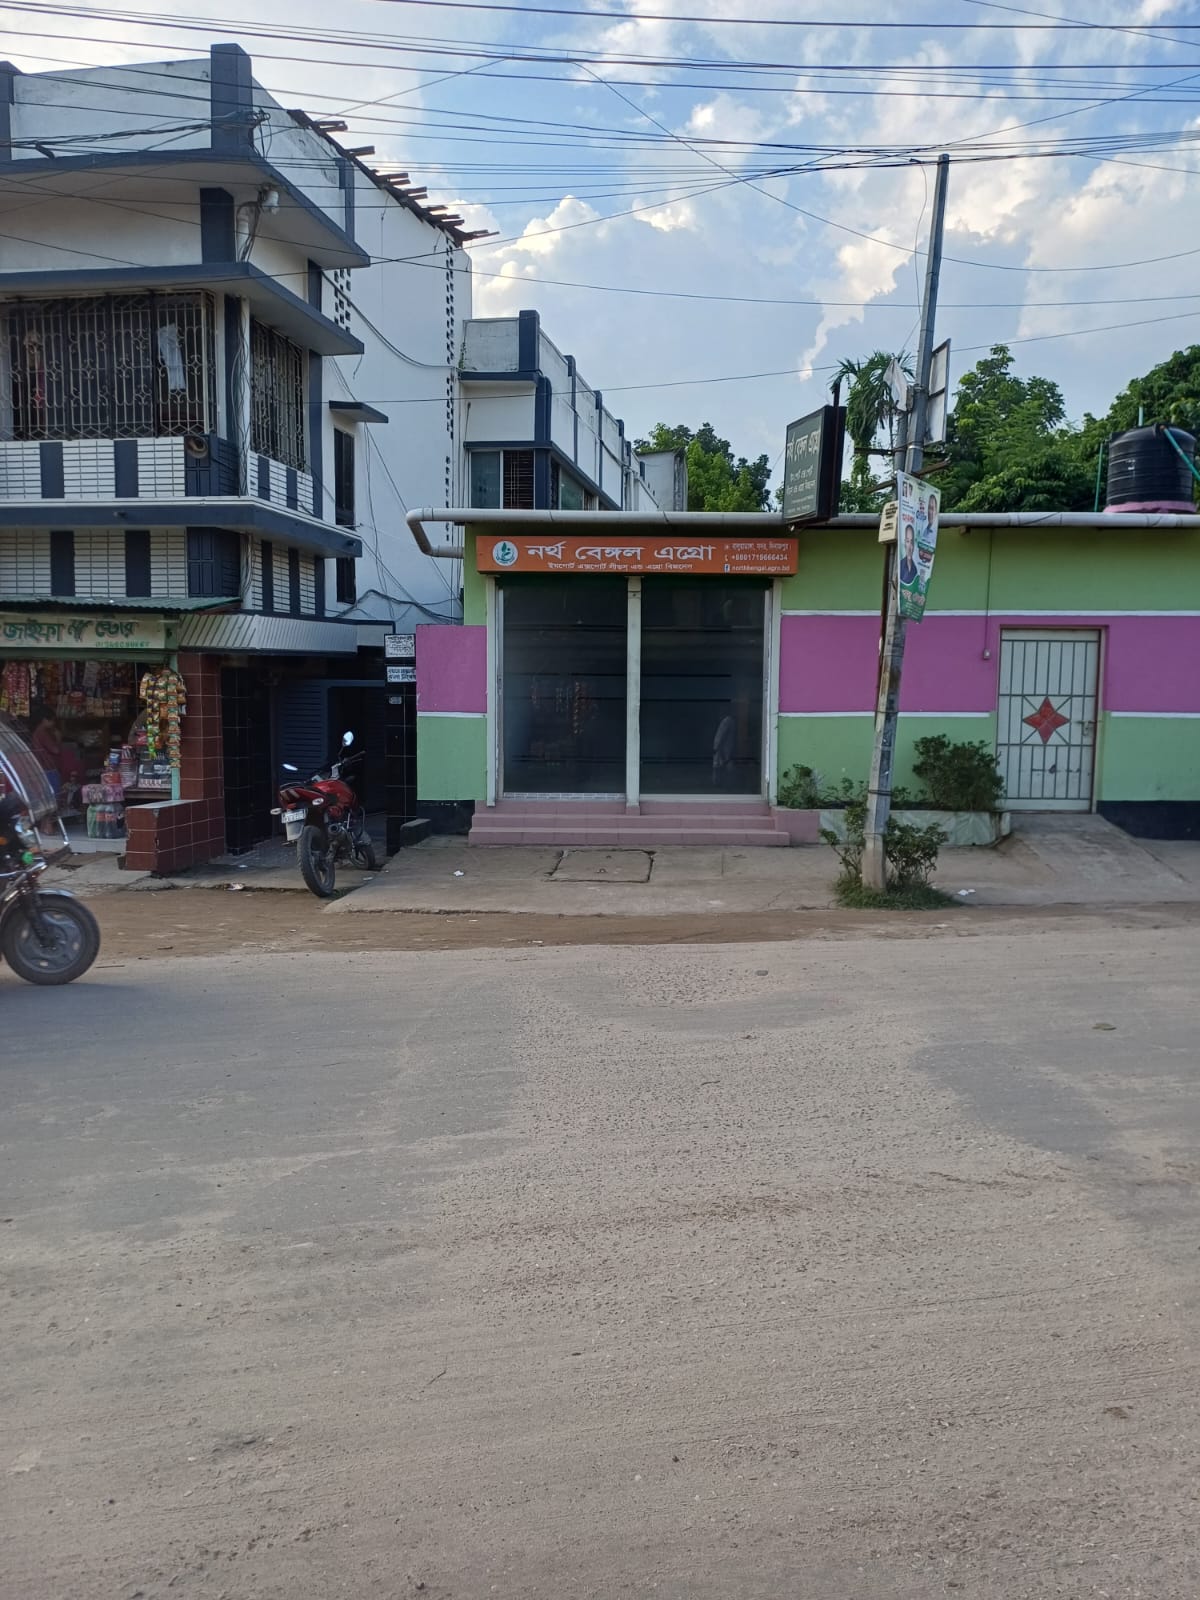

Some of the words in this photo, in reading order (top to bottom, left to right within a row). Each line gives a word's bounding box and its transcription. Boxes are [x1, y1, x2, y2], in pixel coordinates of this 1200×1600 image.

[524, 541, 567, 560] নর্থ
[575, 546, 646, 561] বেঙ্গল
[654, 544, 716, 560] এগ্রো
